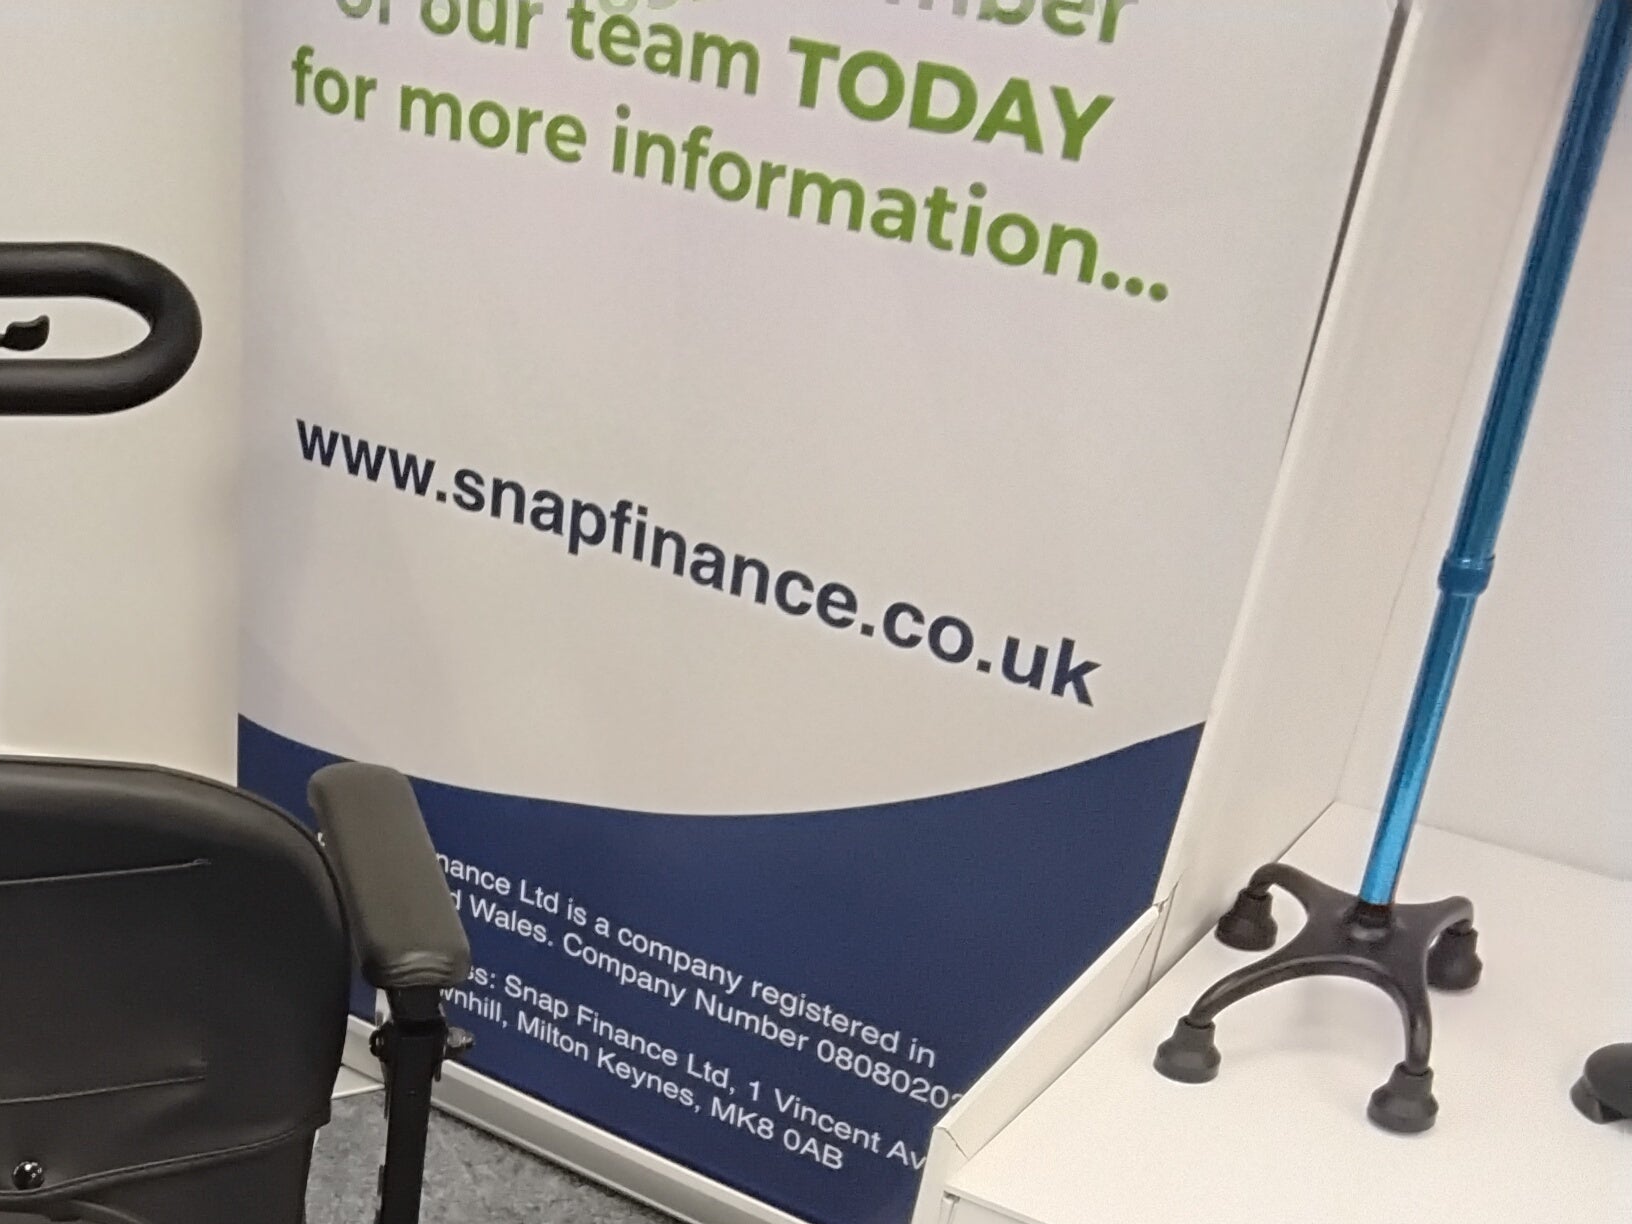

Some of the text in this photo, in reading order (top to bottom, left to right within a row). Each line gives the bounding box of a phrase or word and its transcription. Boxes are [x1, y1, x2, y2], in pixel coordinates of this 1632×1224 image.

[291, 44, 1170, 303] for more information...
[421, 0, 1116, 163] our team TODAY
[296, 418, 1103, 708] www.snapfinance.co.uk
[436, 852, 936, 1069] nance Ltd is a company registered in
[439, 986, 508, 1029] wnhill,
[518, 1010, 589, 1062] Milton
[597, 1045, 703, 1113] Keynes,
[710, 1097, 776, 1140] MK8
[470, 893, 964, 1109] Wales. Company Number 0808020
[504, 974, 569, 1020] Snap
[577, 1004, 678, 1066] Finance
[686, 1052, 736, 1097] Ltd,
[749, 1080, 762, 1101] 1
[774, 1088, 882, 1154] Vincent
[886, 1140, 926, 1170] Av
